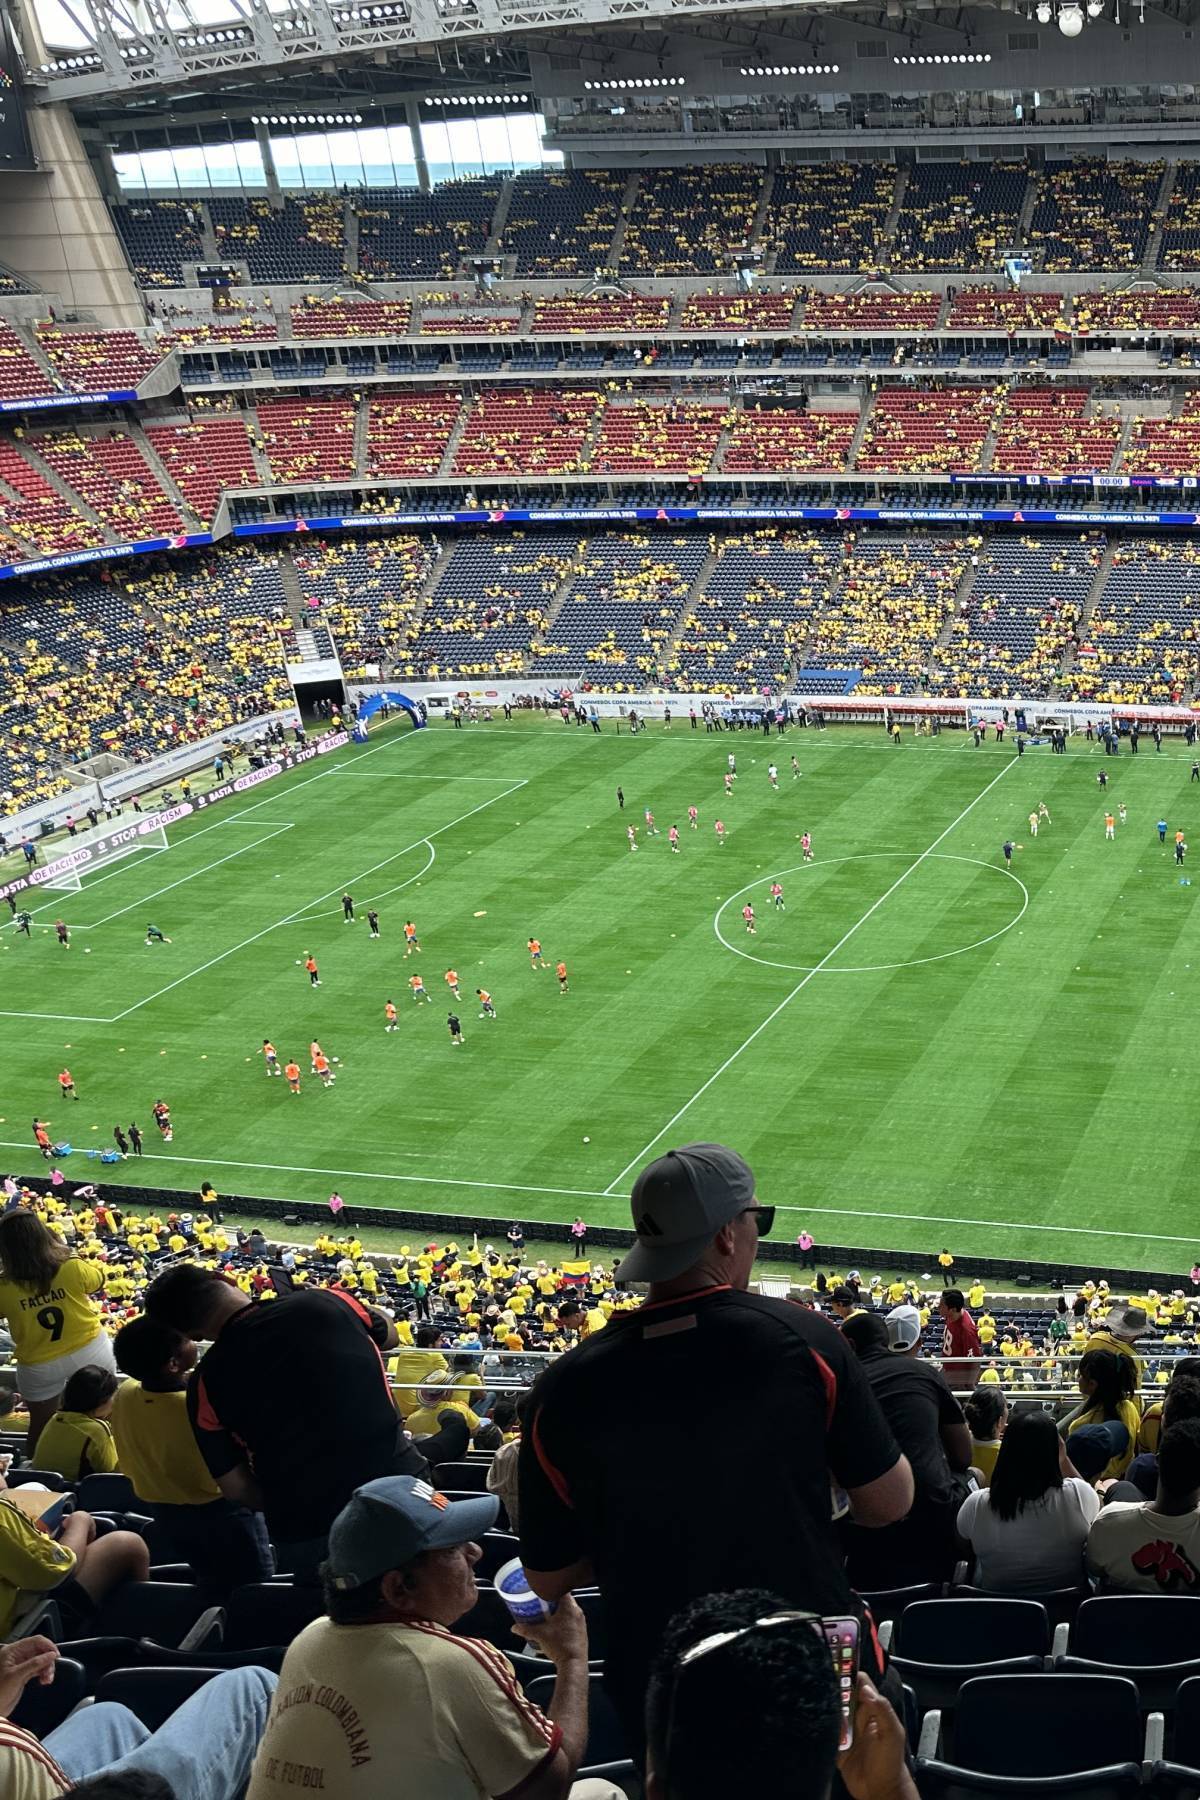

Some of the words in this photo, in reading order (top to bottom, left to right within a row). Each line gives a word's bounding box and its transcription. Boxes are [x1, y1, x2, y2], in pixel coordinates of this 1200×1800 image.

[53, 557, 71, 568] COPA
[296, 746, 316, 763] STOP
[209, 785, 233, 801] BASTA
[237, 779, 248, 788] DE
[249, 765, 279, 784] RACISMO
[111, 828, 137, 846] STOP
[148, 808, 182, 830] RACISM
[33, 869, 47, 882] DE
[50, 852, 88, 874] RACISMO
[20, 1287, 66, 1311] FALCAO
[37, 1306, 65, 1342] 9
[315, 1685, 371, 1768] COLOMBIANA
[266, 1757, 280, 1781] DE
[281, 1761, 325, 1789] FUTBOL
